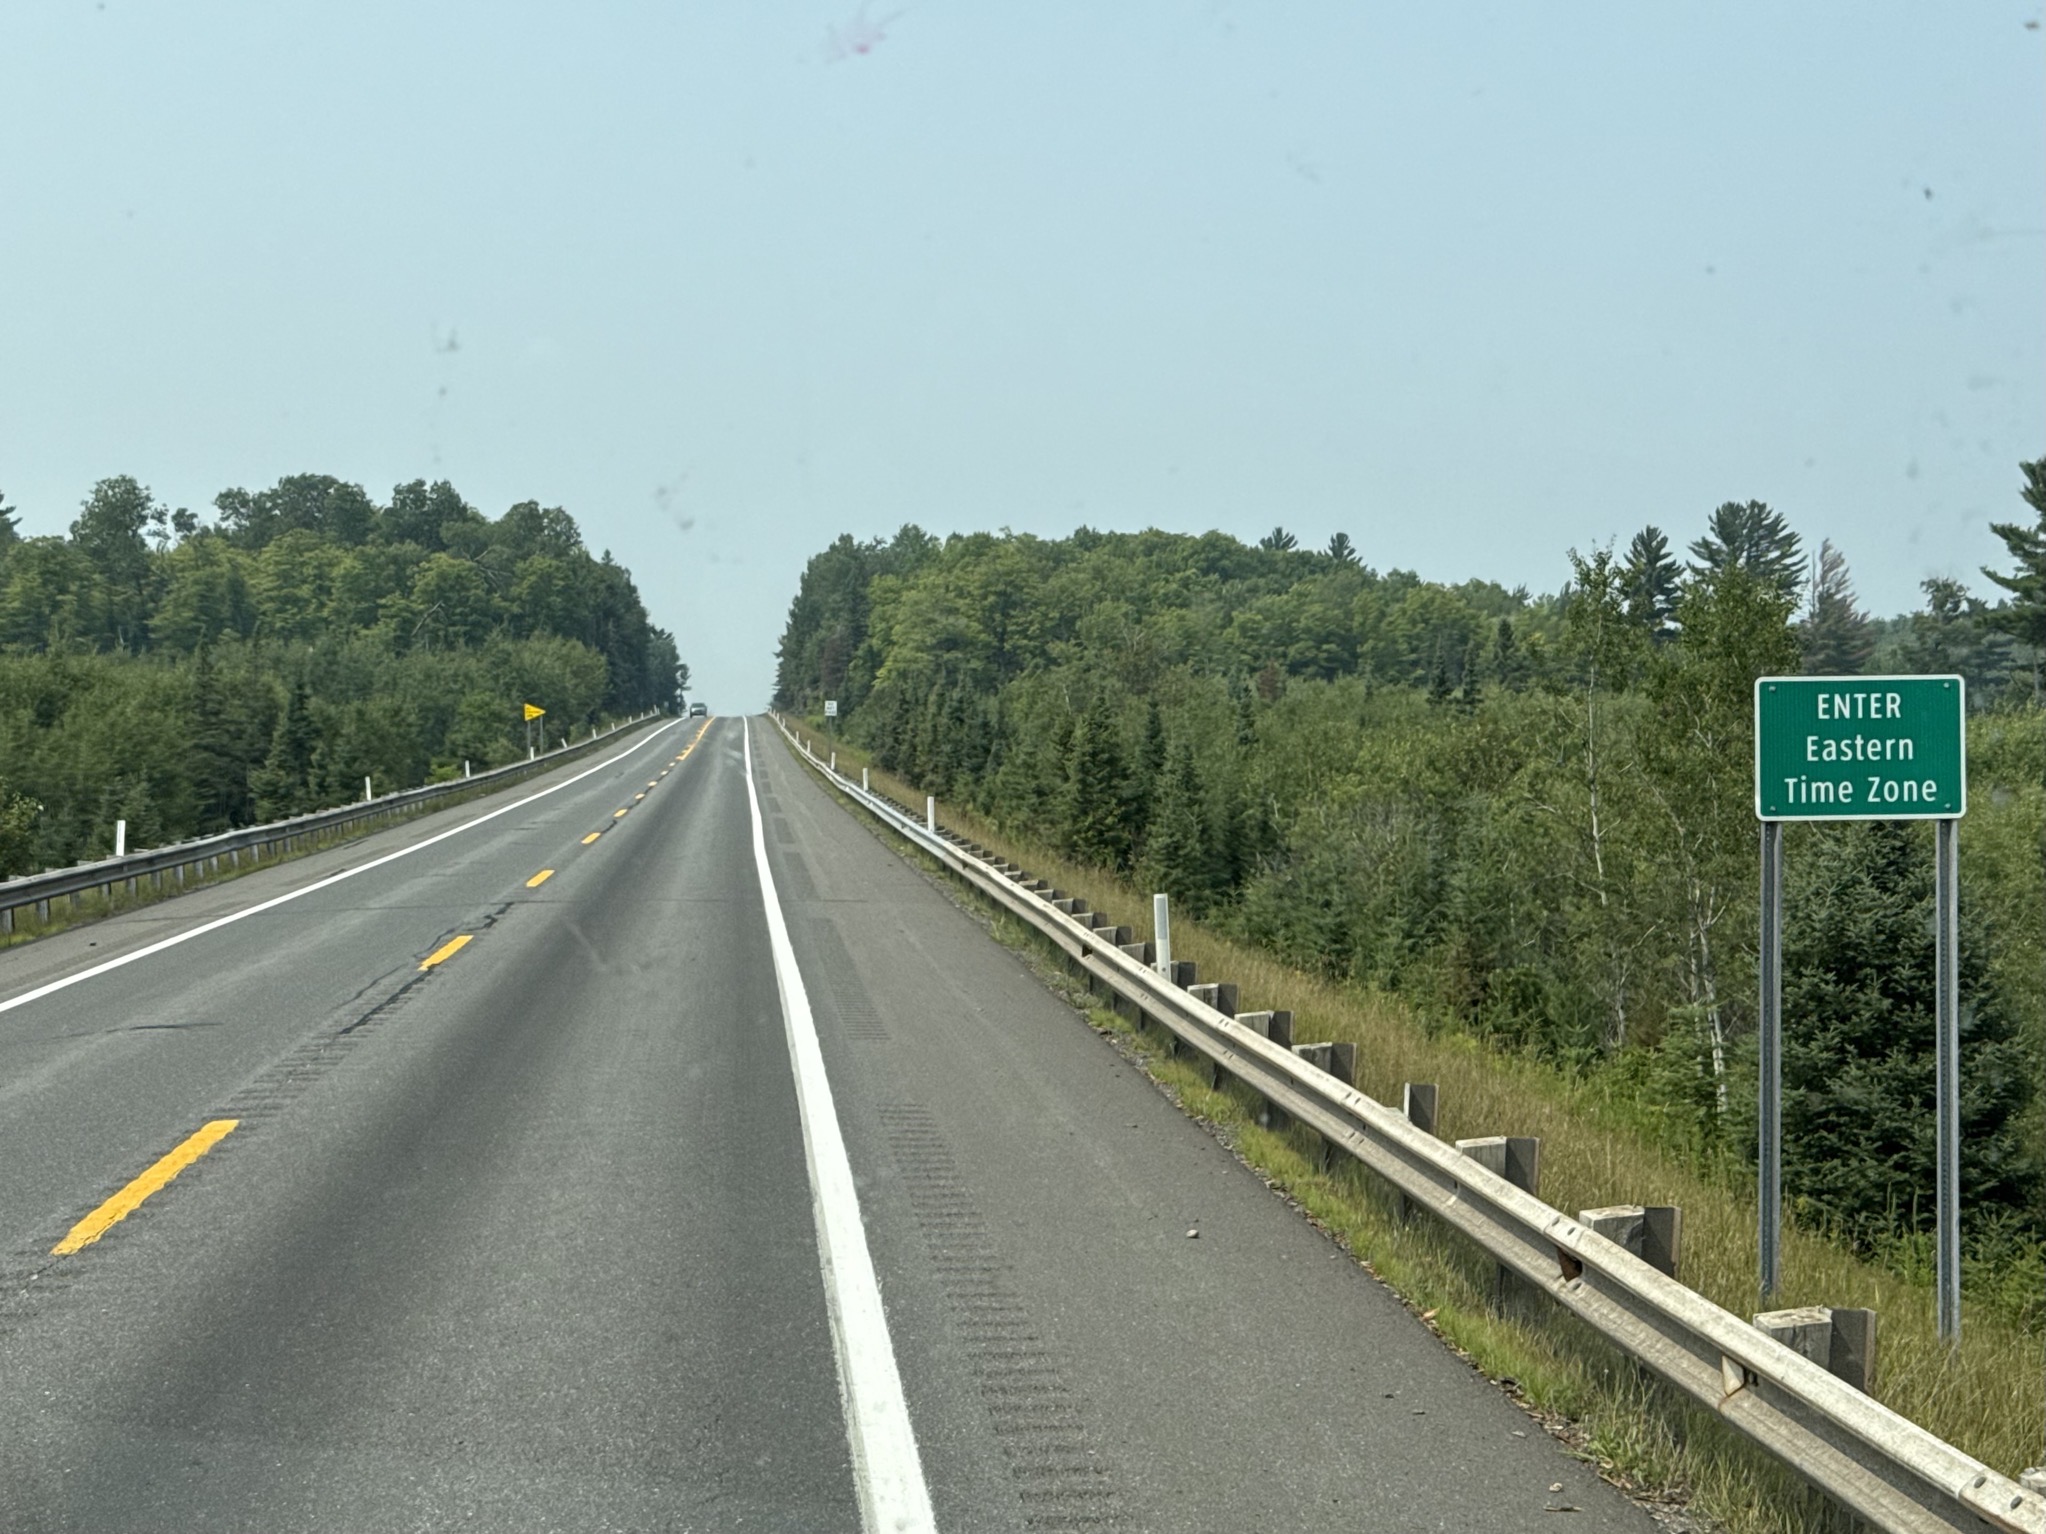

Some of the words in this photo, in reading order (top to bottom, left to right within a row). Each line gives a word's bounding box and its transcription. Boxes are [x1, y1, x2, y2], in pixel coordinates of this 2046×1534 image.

[1817, 692, 1902, 719] ENTER
[1806, 734, 1914, 762] Eastern
[1783, 775, 1854, 804] Time
[1866, 776, 1937, 803] Zone
